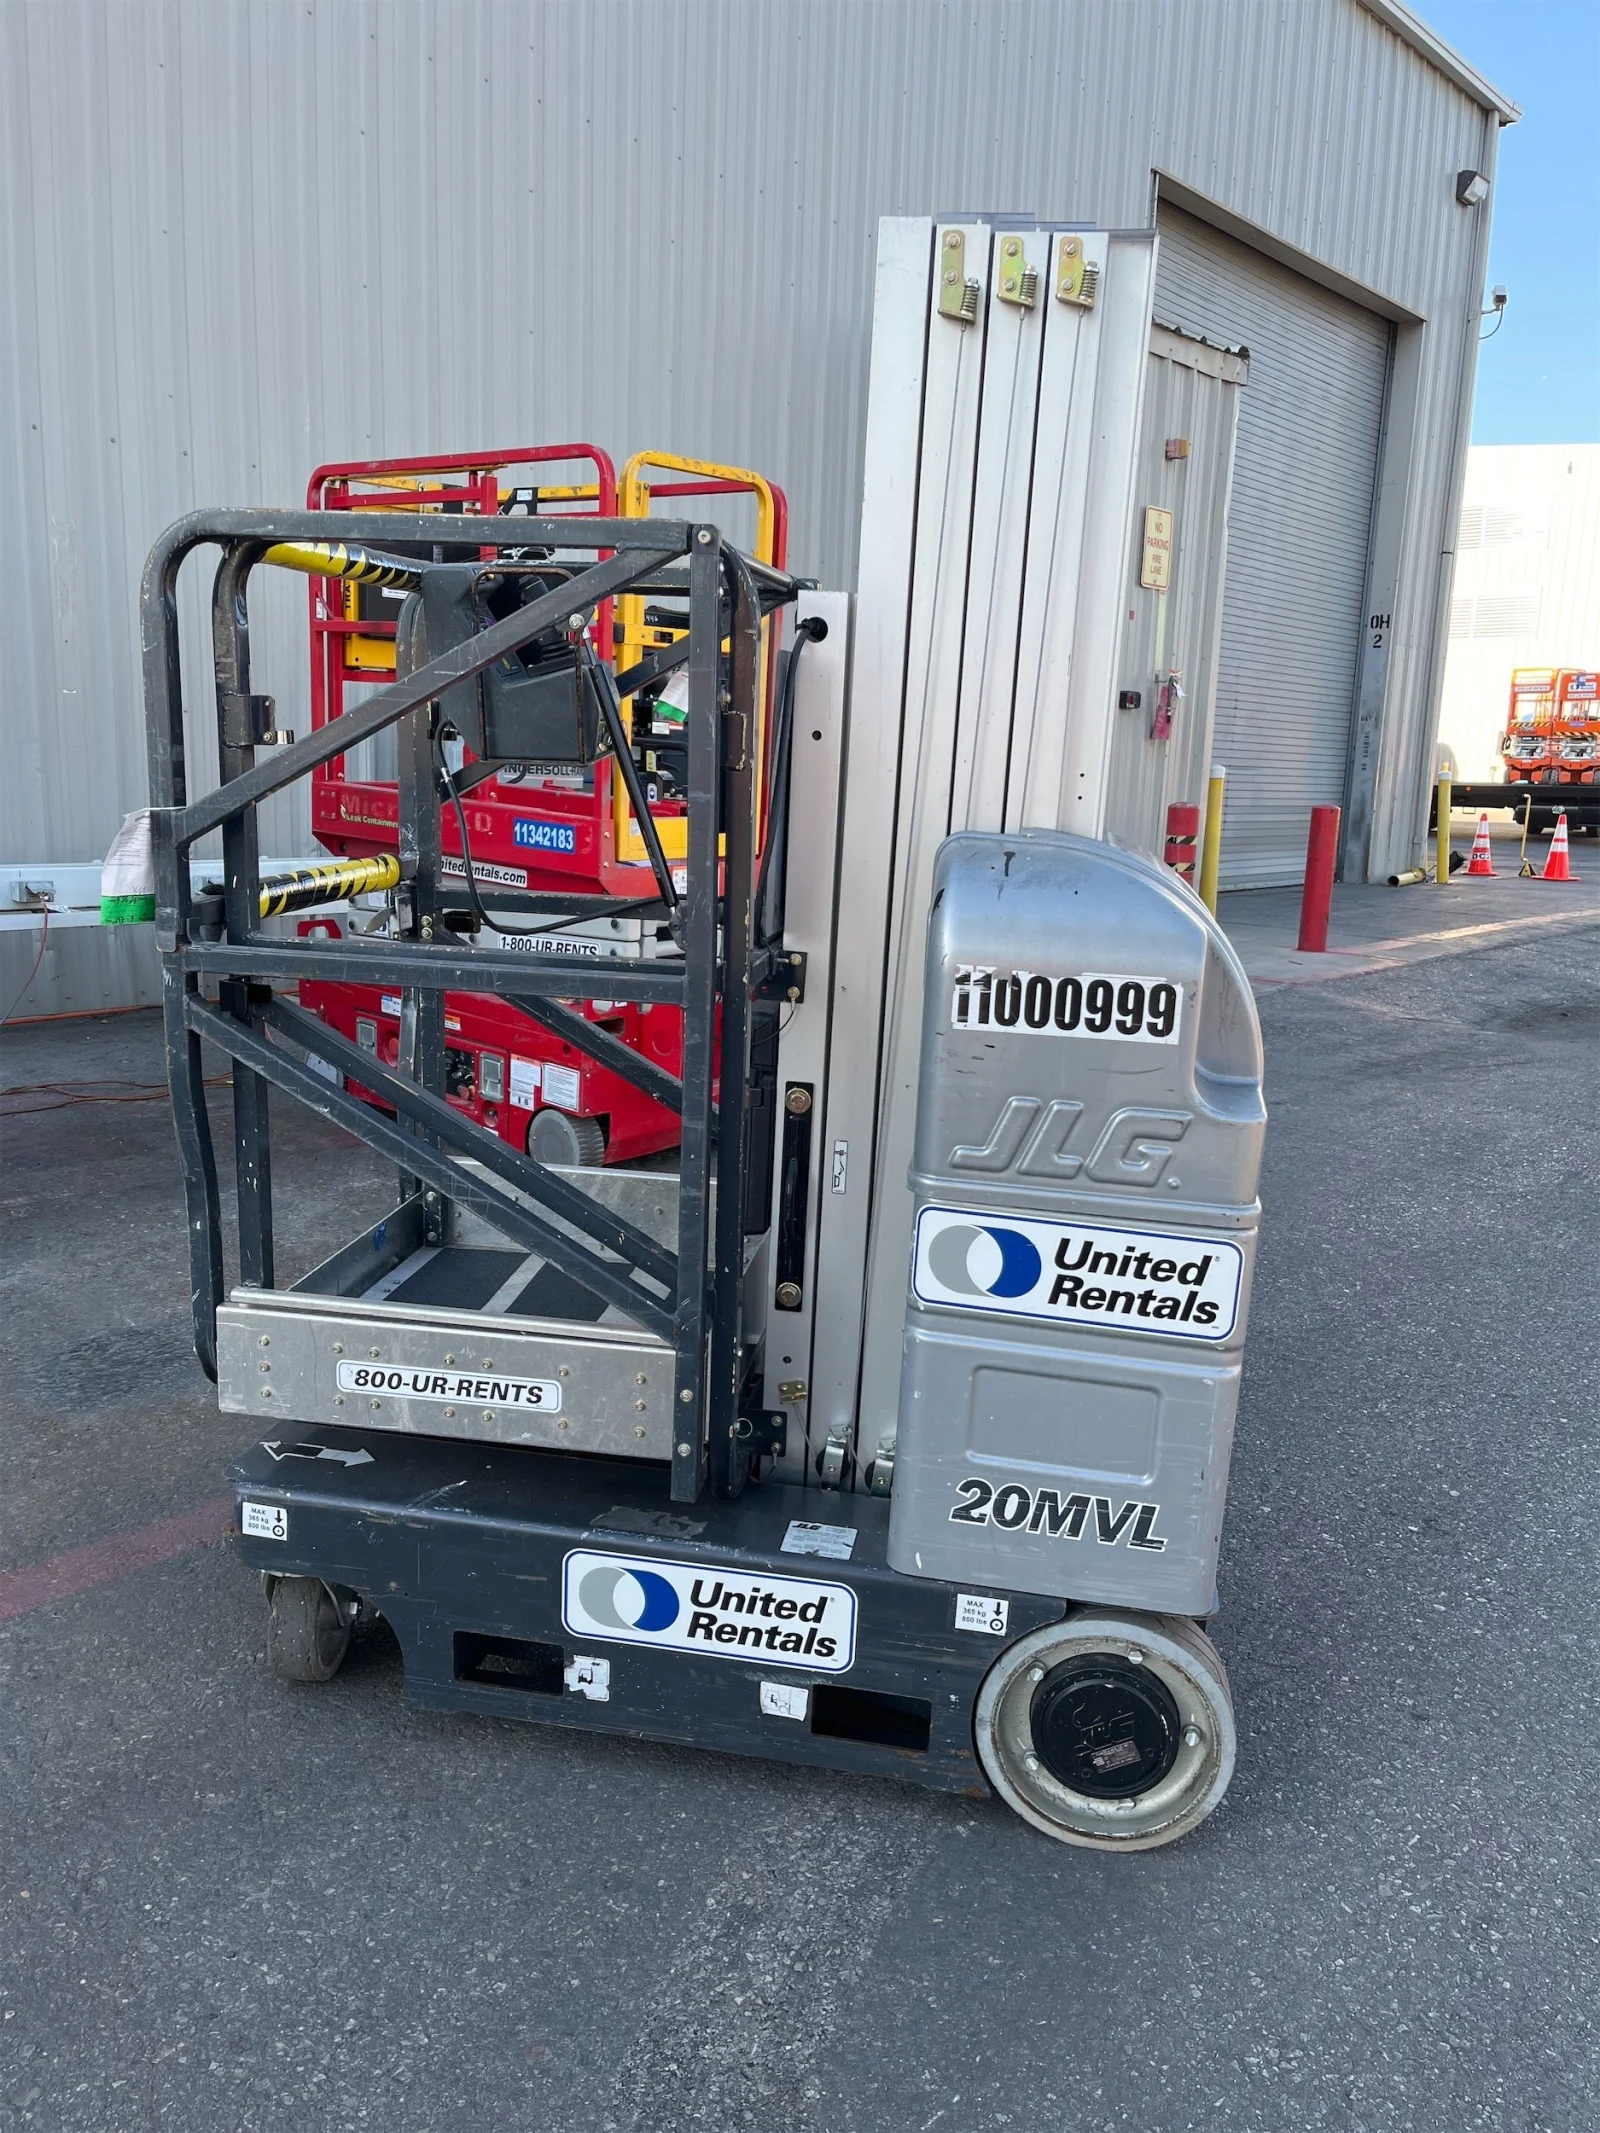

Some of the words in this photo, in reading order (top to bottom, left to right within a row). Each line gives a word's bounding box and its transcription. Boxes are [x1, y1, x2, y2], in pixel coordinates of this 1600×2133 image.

[1155, 522, 1163, 533] NO
[1147, 536, 1169, 551] PARKING
[1152, 554, 1162, 565] FIRE
[1150, 565, 1162, 576] LANE
[1372, 634, 1382, 648] 2
[362, 816, 399, 829] Containmen
[514, 822, 574, 850] 11342183
[954, 973, 1177, 1038] 11000999
[948, 1096, 1192, 1187] JLG
[1054, 1237, 1212, 1286] United
[1047, 1275, 1219, 1325] Rentals
[354, 1369, 543, 1405] 800-UR-RENTS
[251, 1508, 266, 1516] MAX
[949, 1477, 1168, 1553] 20MVL
[260, 1517, 269, 1525] kg
[690, 1579, 828, 1624] United
[967, 1600, 984, 1608] MAX
[962, 1607, 976, 1615] 365
[977, 1609, 987, 1618] kg
[976, 1617, 988, 1625] lbs
[687, 1611, 838, 1658] Rentals
